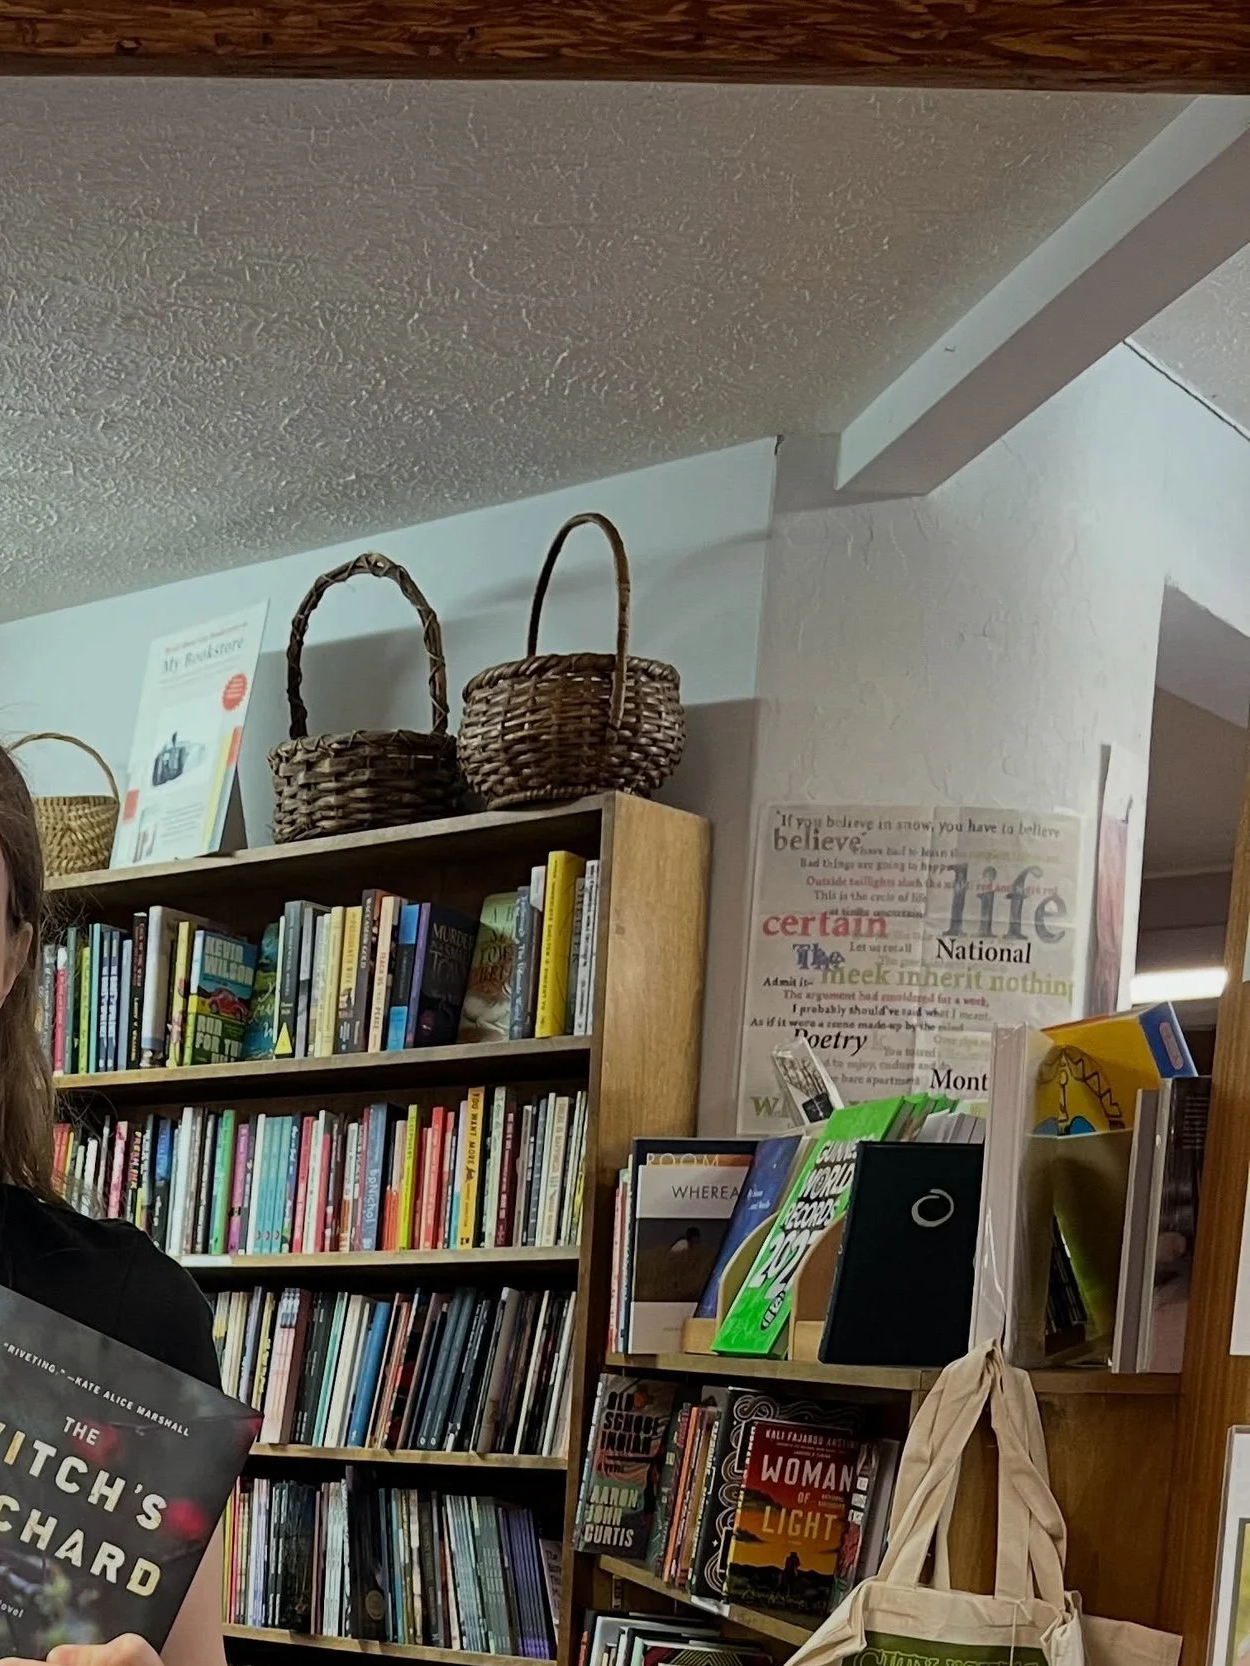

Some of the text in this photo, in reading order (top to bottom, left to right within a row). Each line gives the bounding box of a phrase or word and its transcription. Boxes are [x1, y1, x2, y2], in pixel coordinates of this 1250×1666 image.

[161, 657, 179, 674] My
[184, 636, 245, 668] Bookstore
[796, 815, 1061, 839] you believe in snow, you have to believe
[801, 858, 820, 869] Bad
[823, 858, 854, 872] things
[806, 875, 848, 888] Outside
[814, 889, 868, 901] This the
[942, 863, 1068, 944] life
[762, 910, 888, 938] certain
[205, 937, 244, 958] KEVIN
[793, 943, 845, 970] The
[850, 941, 866, 953] Let
[936, 937, 1032, 964] National
[204, 954, 254, 985] WILSON
[763, 976, 797, 988] Admit
[822, 965, 982, 991] meek inherit
[783, 989, 856, 1004] The argument
[800, 1003, 950, 1018] probably said what
[751, 1017, 763, 1027] As
[905, 1020, 916, 1033] by
[929, 1067, 990, 1092] Mont
[467, 1113, 479, 1165] WANT MORE
[671, 1185, 739, 1199] WHEREA
[800, 1162, 856, 1198] WORLD
[365, 1168, 380, 1224] bpNichol
[784, 1198, 839, 1230] RECORDS
[103, 1389, 134, 1411] ALICE
[136, 1404, 190, 1438] MARSHALL
[62, 1416, 100, 1446] THE
[766, 1428, 786, 1441] KALI
[760, 1454, 854, 1493] WOMAN
[589, 1484, 639, 1509] AARON
[797, 1491, 811, 1504] OF
[585, 1504, 623, 1526] JOHN
[762, 1504, 838, 1542] LIGHT
[583, 1524, 635, 1548] CURTIS
